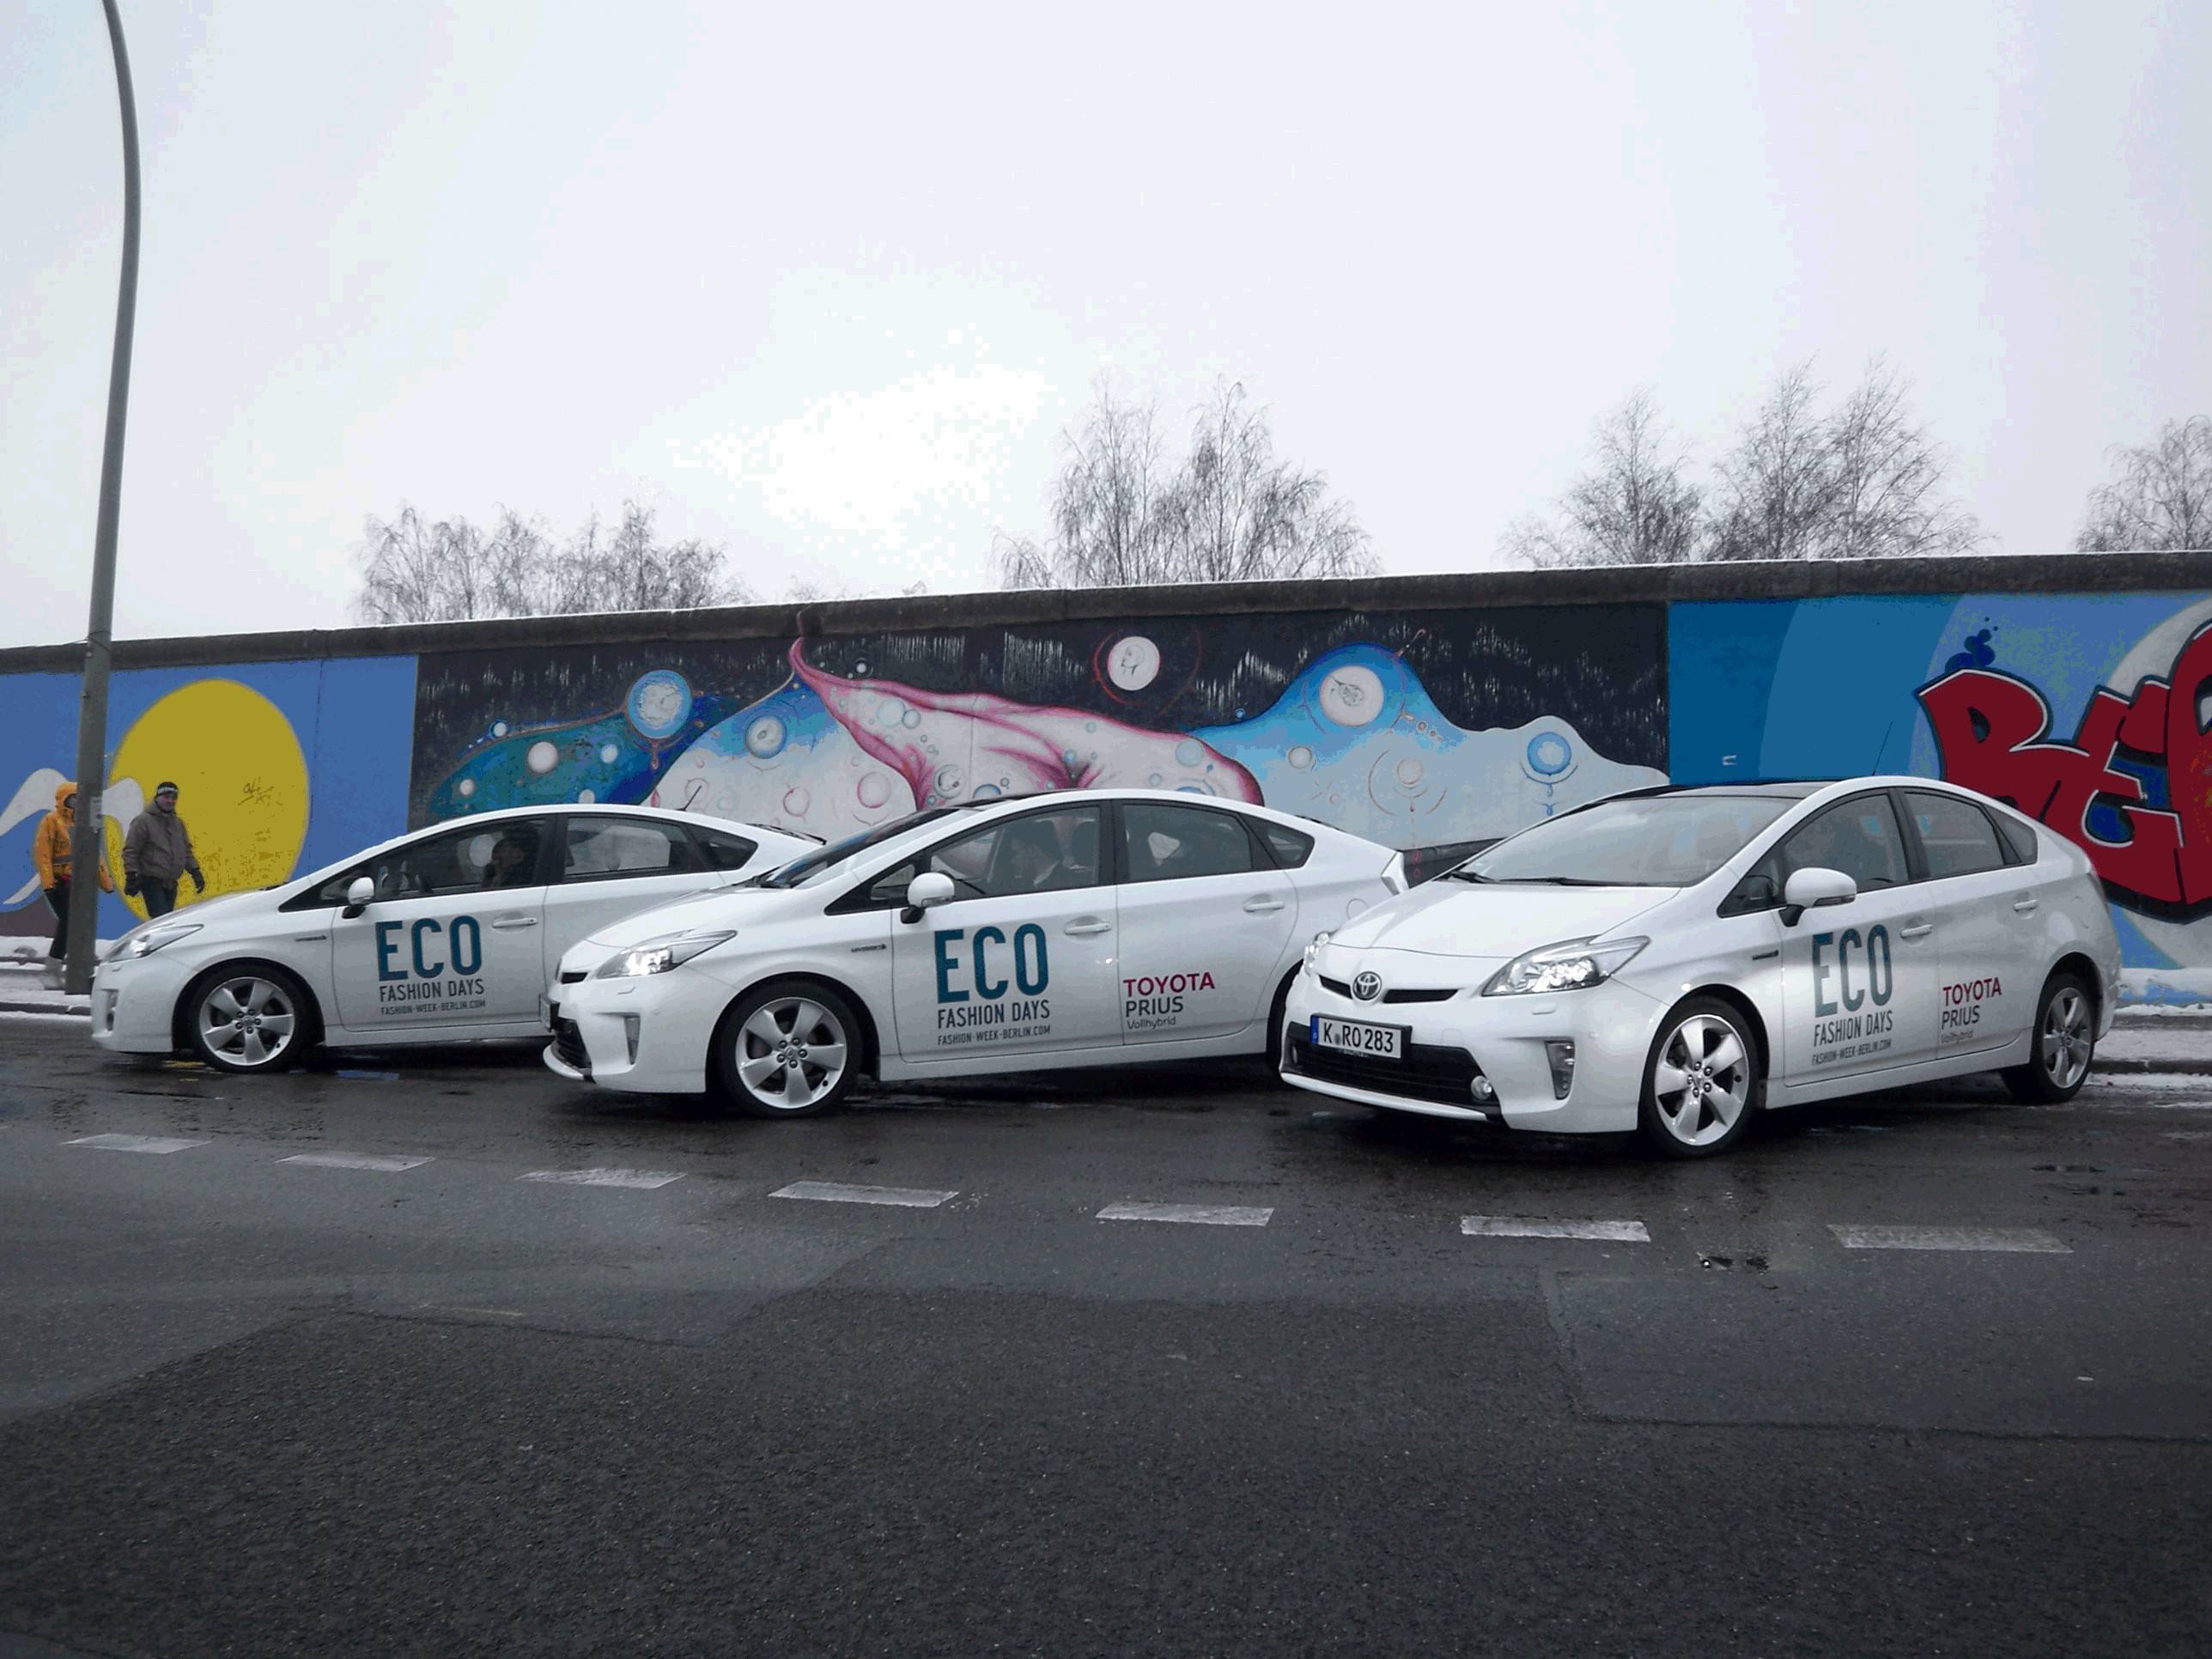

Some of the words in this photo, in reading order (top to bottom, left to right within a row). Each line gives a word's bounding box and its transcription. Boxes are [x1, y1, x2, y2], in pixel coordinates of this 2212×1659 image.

[375, 915, 483, 981] ECO
[934, 923, 1049, 1004] ECO
[1812, 924, 1893, 1018] ECO
[379, 981, 442, 1002] FASHION
[448, 978, 484, 996] DAYS
[1123, 971, 1215, 998] TOYOTA
[1942, 977, 2002, 1006] TOYOTA
[938, 1003, 1005, 1029] FASHION
[1012, 999, 1050, 1023] DAYS
[1126, 995, 1184, 1018] PRIUS
[1941, 1005, 1980, 1030] PRIUS
[938, 1024, 1050, 1046] FASHION-WEEK-BERLIN.COM
[1127, 1016, 1176, 1030] Vollhybrid
[1323, 1022, 1333, 1043] K
[1364, 1029, 1394, 1053] 283
[1813, 1017, 1862, 1047] FASHION
[1866, 1010, 1893, 1036] DAYS
